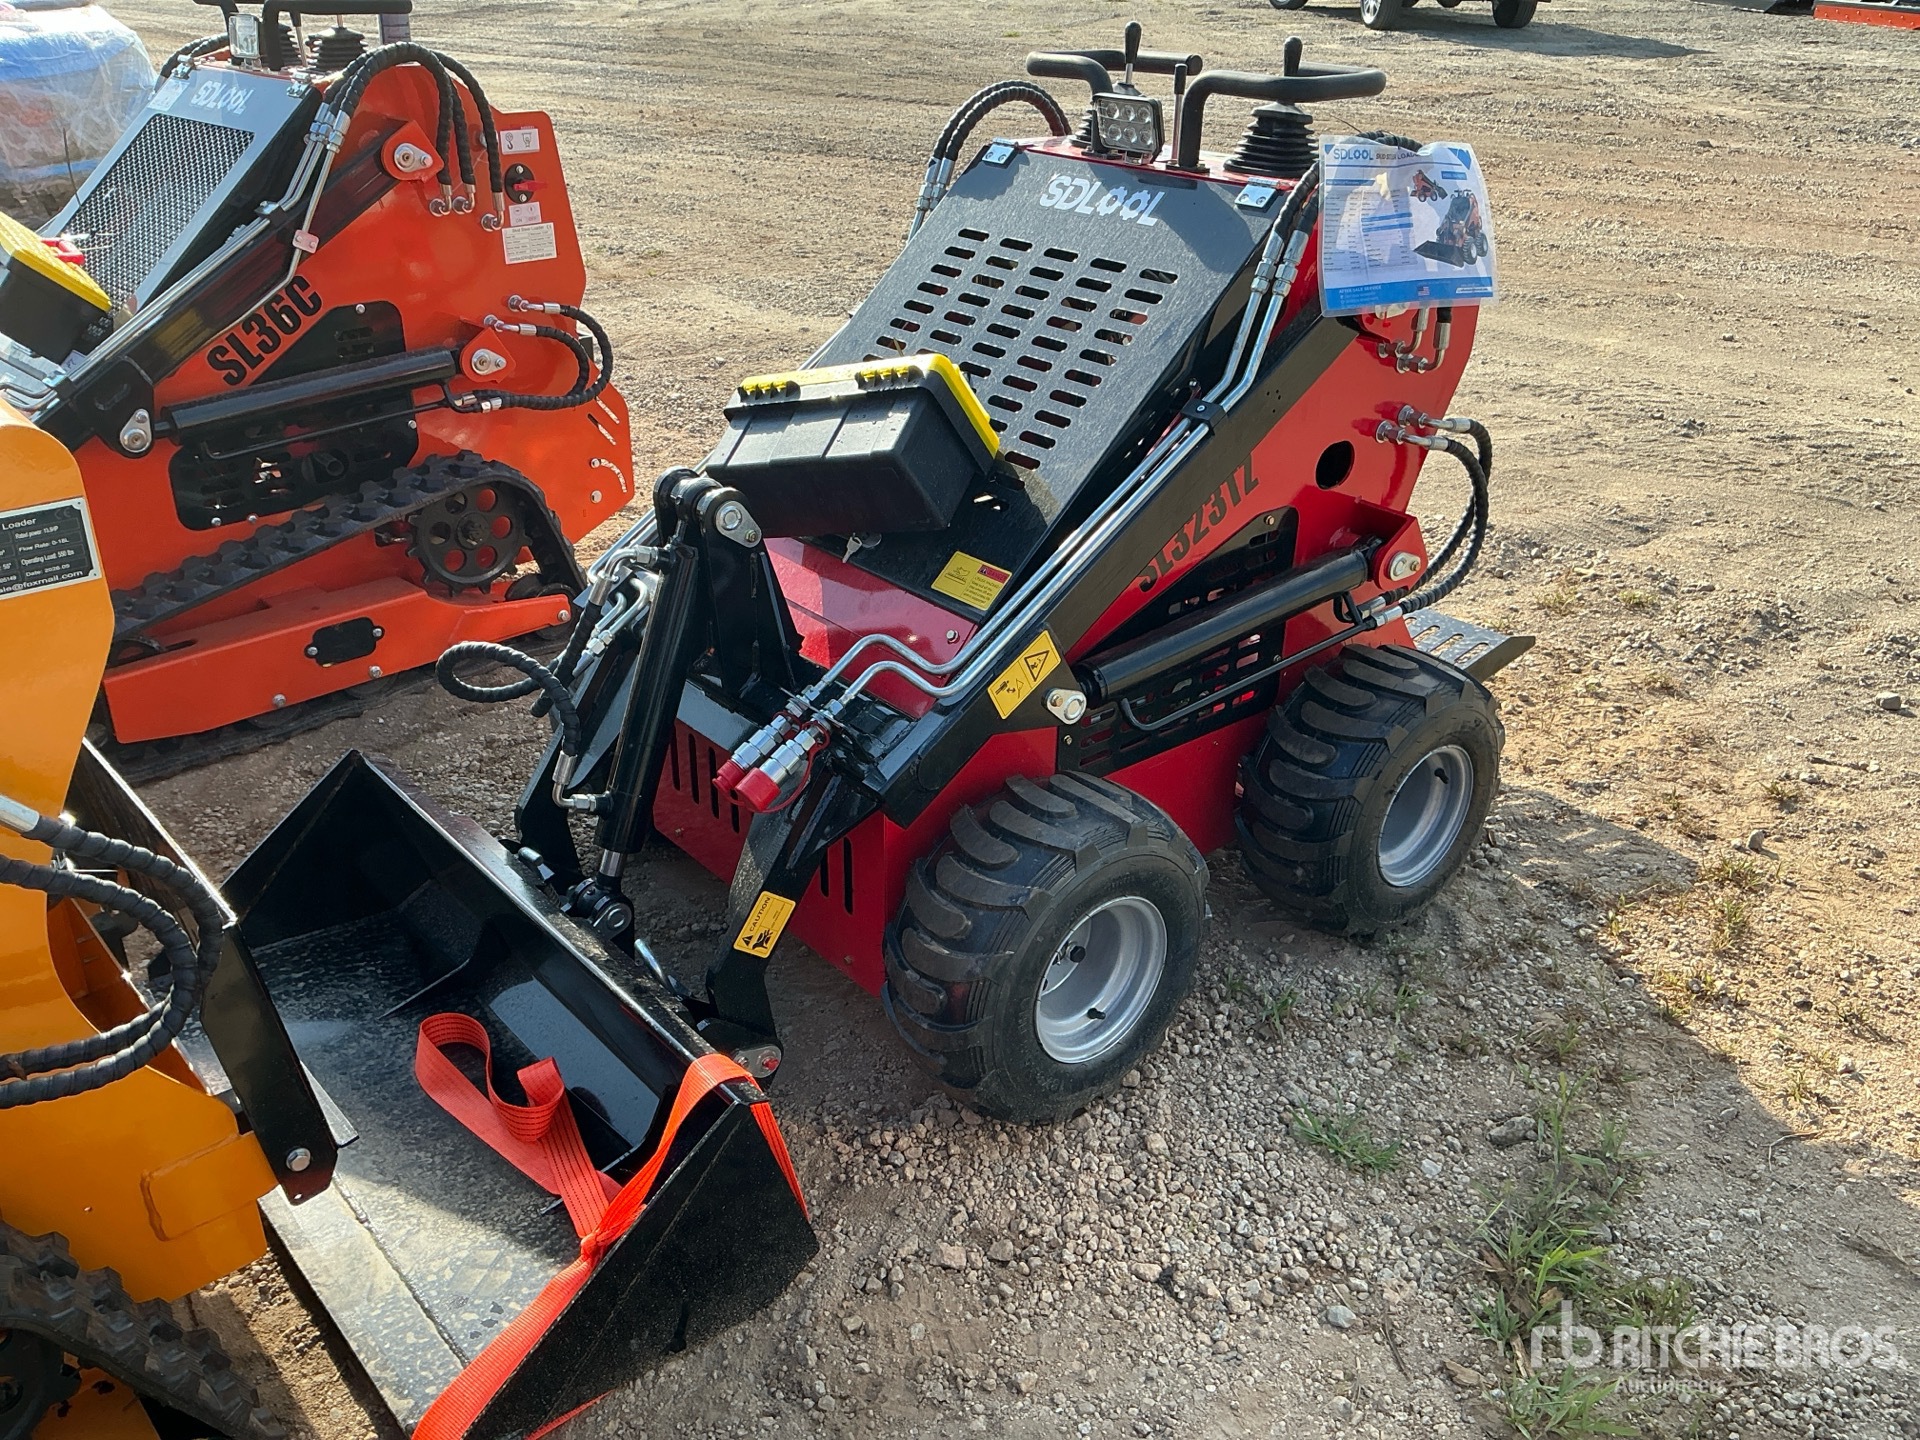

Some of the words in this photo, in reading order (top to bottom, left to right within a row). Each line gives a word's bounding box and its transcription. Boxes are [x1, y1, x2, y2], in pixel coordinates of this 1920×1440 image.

[1333, 148, 1373, 161] SDLOOL
[1039, 175, 1166, 227] SDLOOL
[206, 275, 323, 386] SL36C
[2, 518, 36, 530] Loader
[21, 556, 44, 566] Operating
[749, 896, 771, 932] CAUTION
